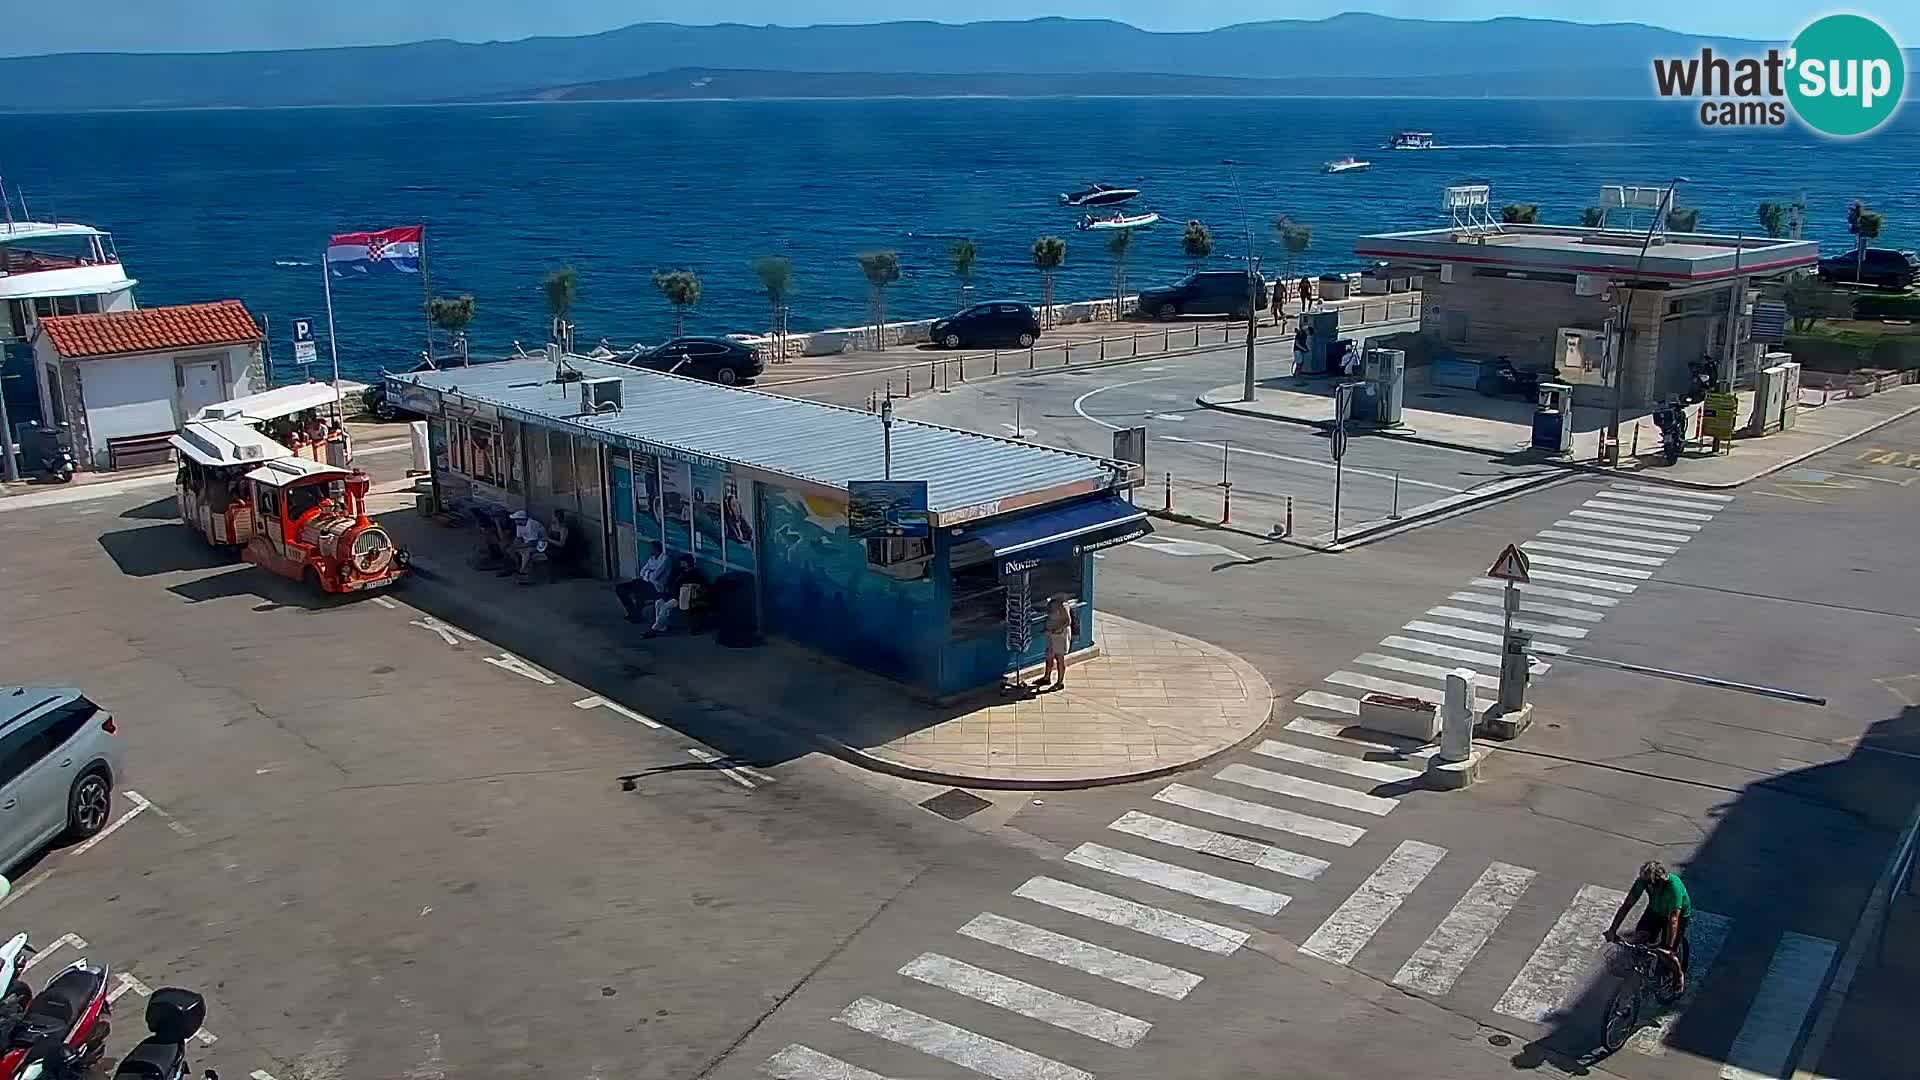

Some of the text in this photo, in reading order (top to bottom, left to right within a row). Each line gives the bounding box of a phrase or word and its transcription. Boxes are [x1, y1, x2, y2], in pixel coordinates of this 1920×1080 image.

[296, 321, 309, 340] P
[641, 443, 673, 458] STATION
[675, 450, 699, 465] TICKET
[701, 458, 730, 473] OFFICE
